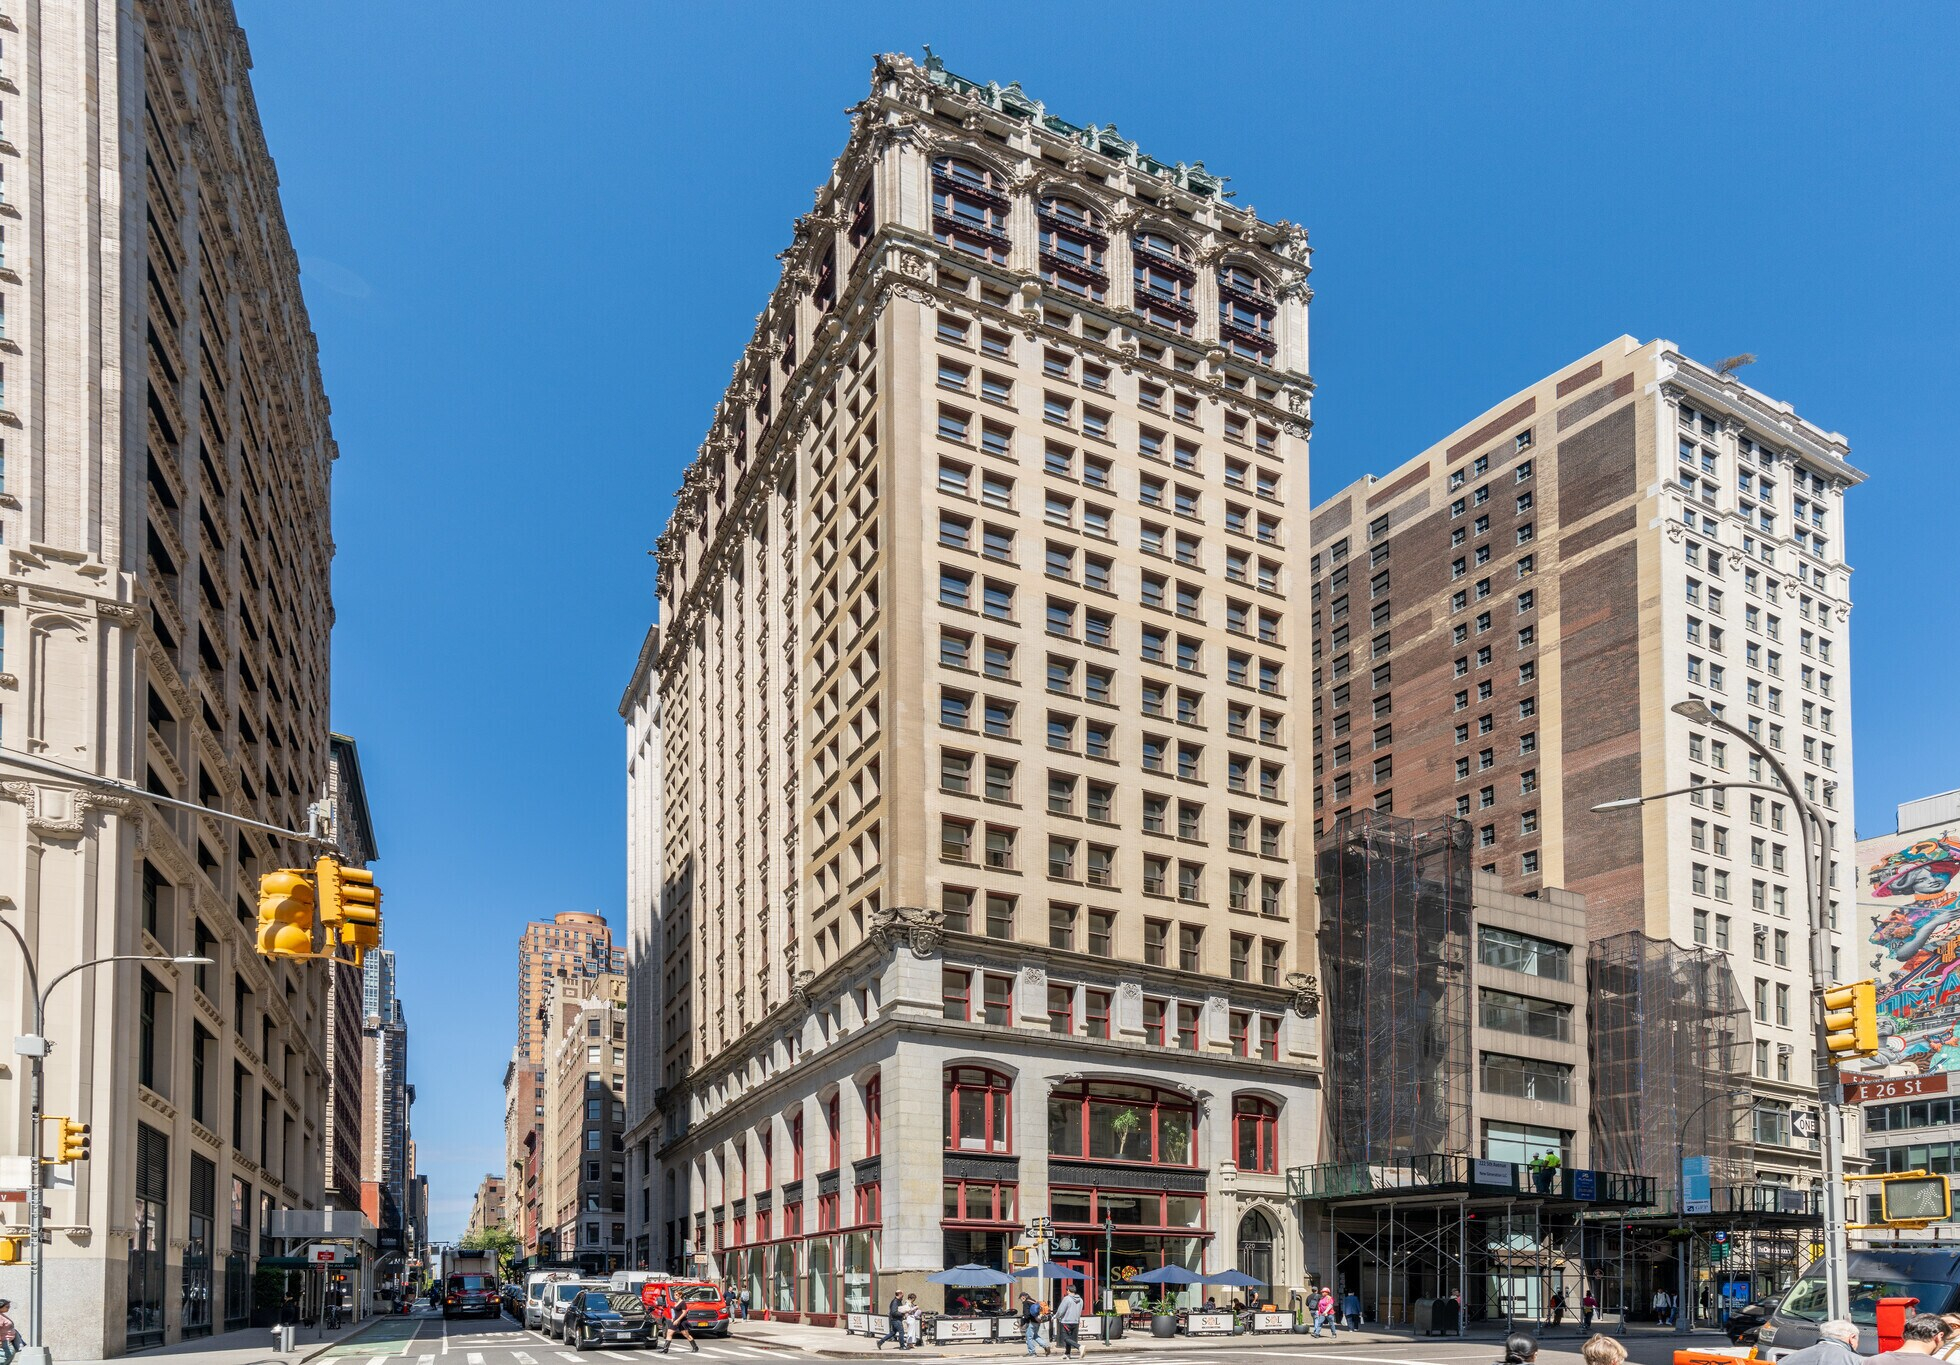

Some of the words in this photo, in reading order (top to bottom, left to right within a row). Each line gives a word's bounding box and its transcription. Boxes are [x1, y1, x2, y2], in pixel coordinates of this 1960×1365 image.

[1861, 1086, 1869, 1099] E
[1876, 1083, 1896, 1097] 26
[1904, 1079, 1922, 1094] St
[1800, 1119, 1815, 1131] ONE
[1051, 1238, 1080, 1250] SOL
[1244, 1242, 1256, 1250] 220
[1201, 1316, 1221, 1326] SOL
[1265, 1315, 1283, 1324] SOL
[951, 1322, 976, 1333] SOL
